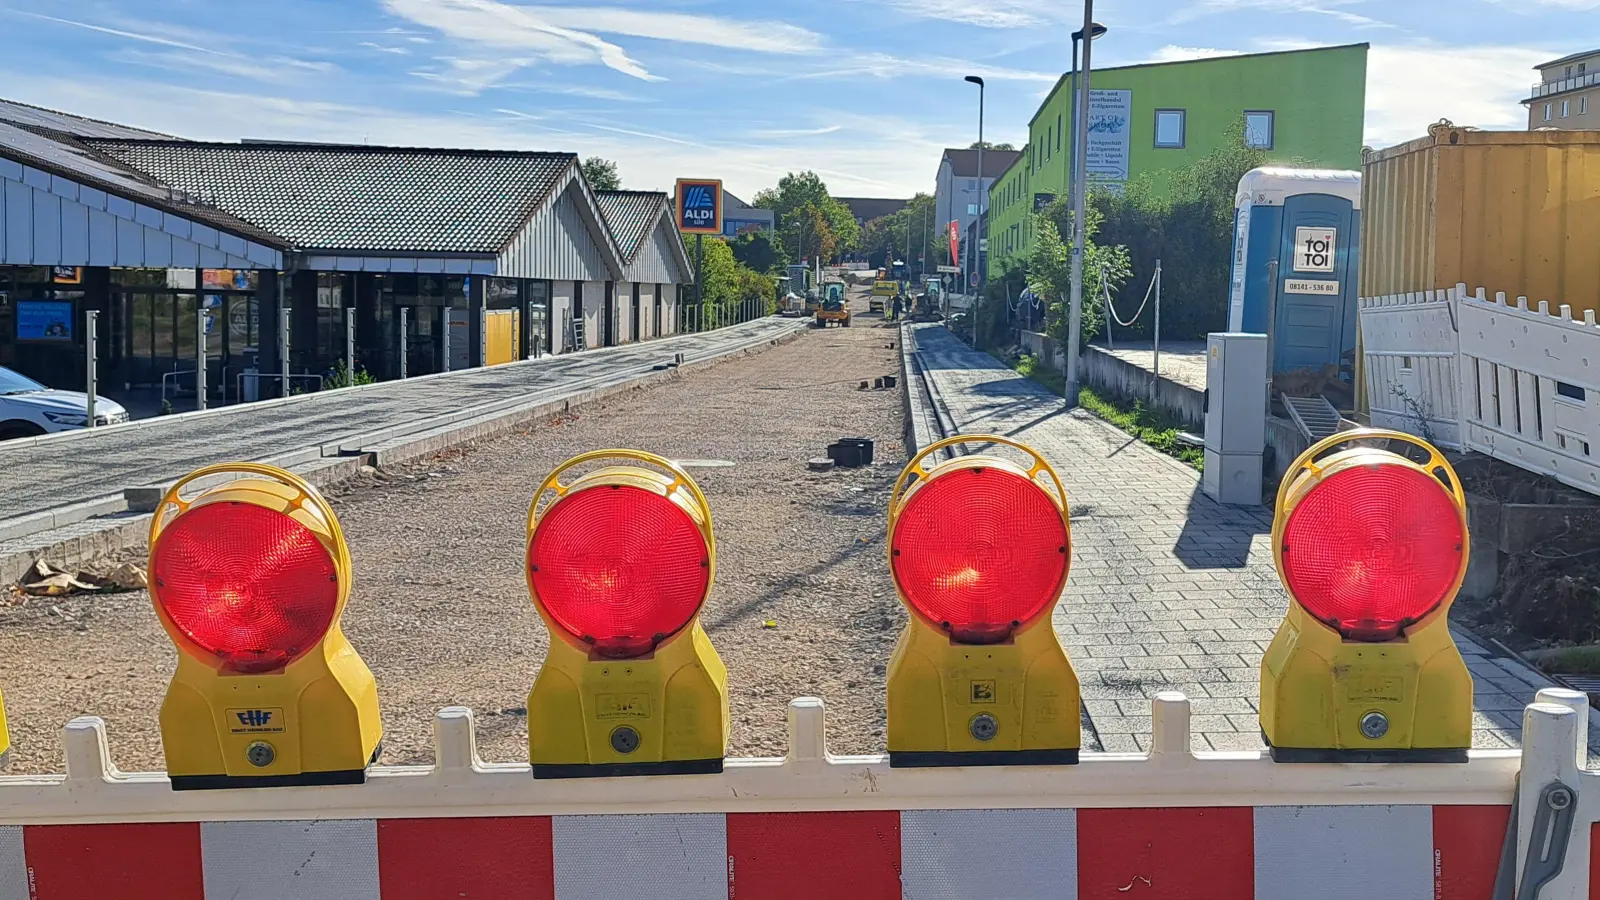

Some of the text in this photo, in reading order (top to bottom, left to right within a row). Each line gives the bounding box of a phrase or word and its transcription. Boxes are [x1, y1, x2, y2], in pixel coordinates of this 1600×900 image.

[684, 209, 714, 220] ALDI
[1304, 253, 1329, 267] TOI
[236, 710, 272, 726] EHF
